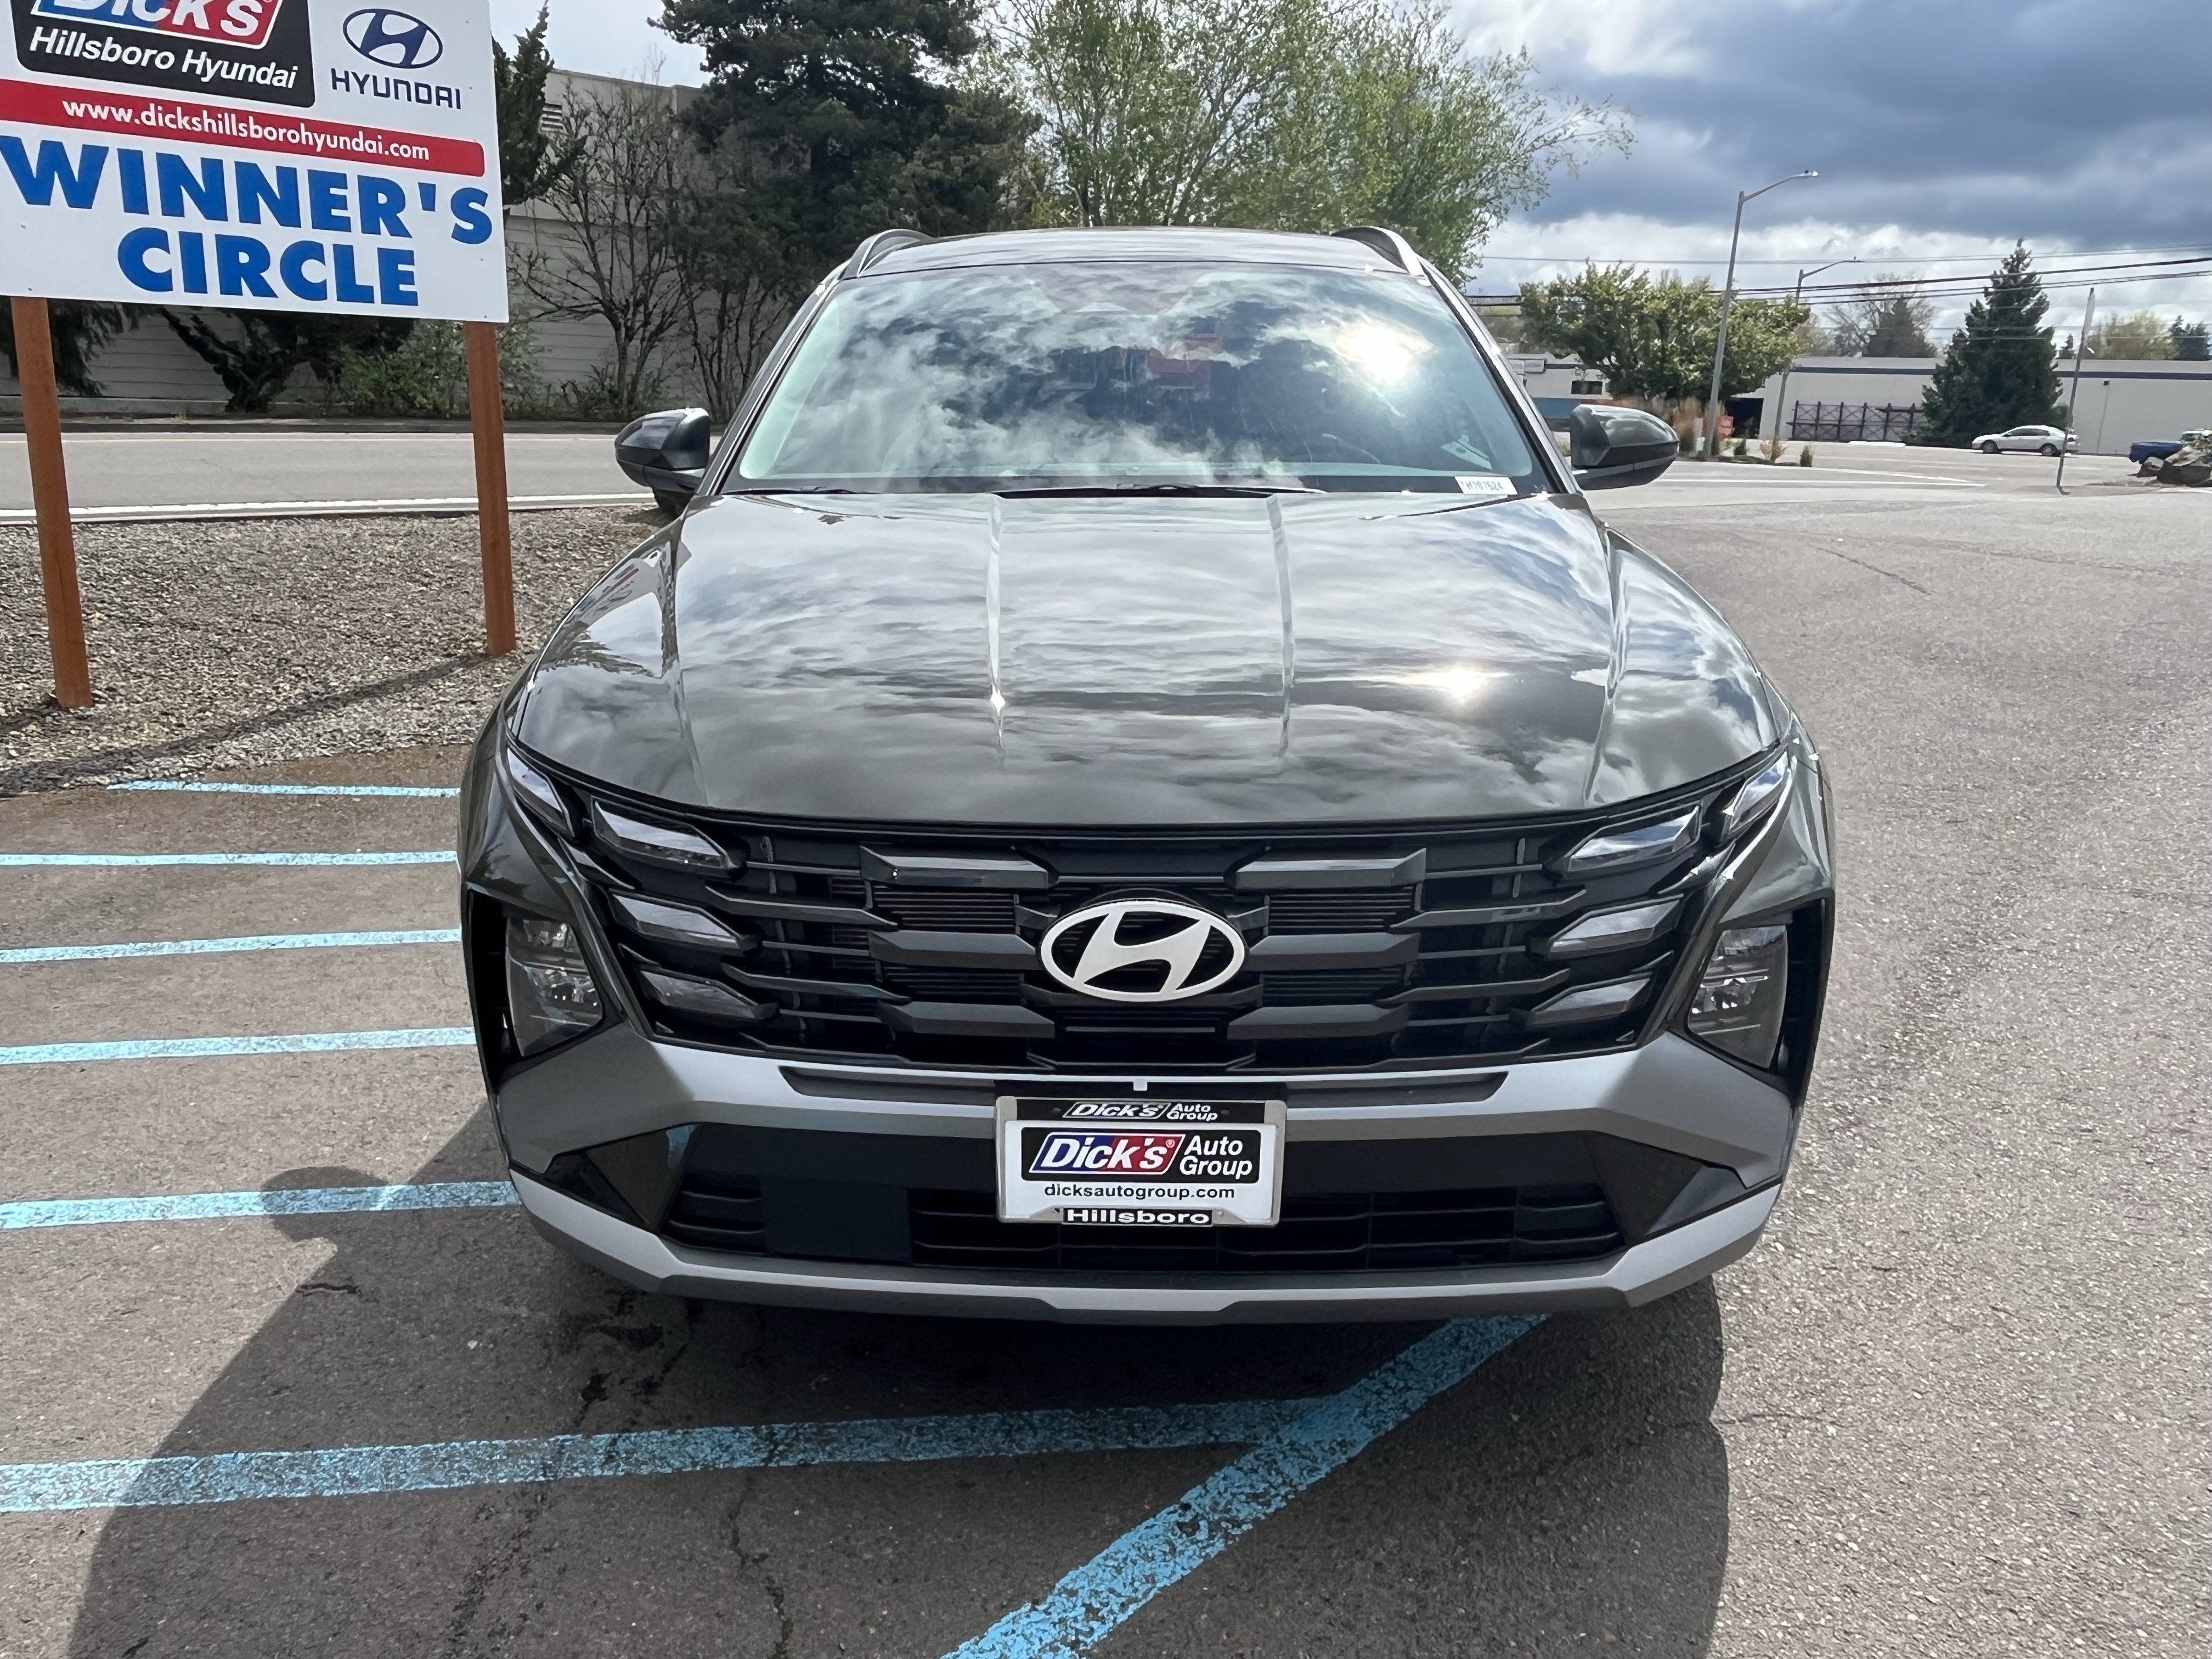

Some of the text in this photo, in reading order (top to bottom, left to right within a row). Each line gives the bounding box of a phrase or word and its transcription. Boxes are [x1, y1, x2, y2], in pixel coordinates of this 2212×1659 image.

[30, 26, 298, 88] Hillsboro Hyundai
[331, 69, 461, 110] HYUNDAI
[62, 100, 430, 161] www.dickshillsborohyundai.com
[0, 135, 492, 244] WINNER'S
[118, 227, 419, 306] CIRCLE
[1166, 1111, 1218, 1121] Group
[1171, 1103, 1211, 1113] Auto
[1183, 1135, 1243, 1156] Auto
[1180, 1155, 1252, 1180] Group
[1044, 1183, 1234, 1200] dicksautogroup.com
[1067, 1209, 1210, 1224] Hillsboro
